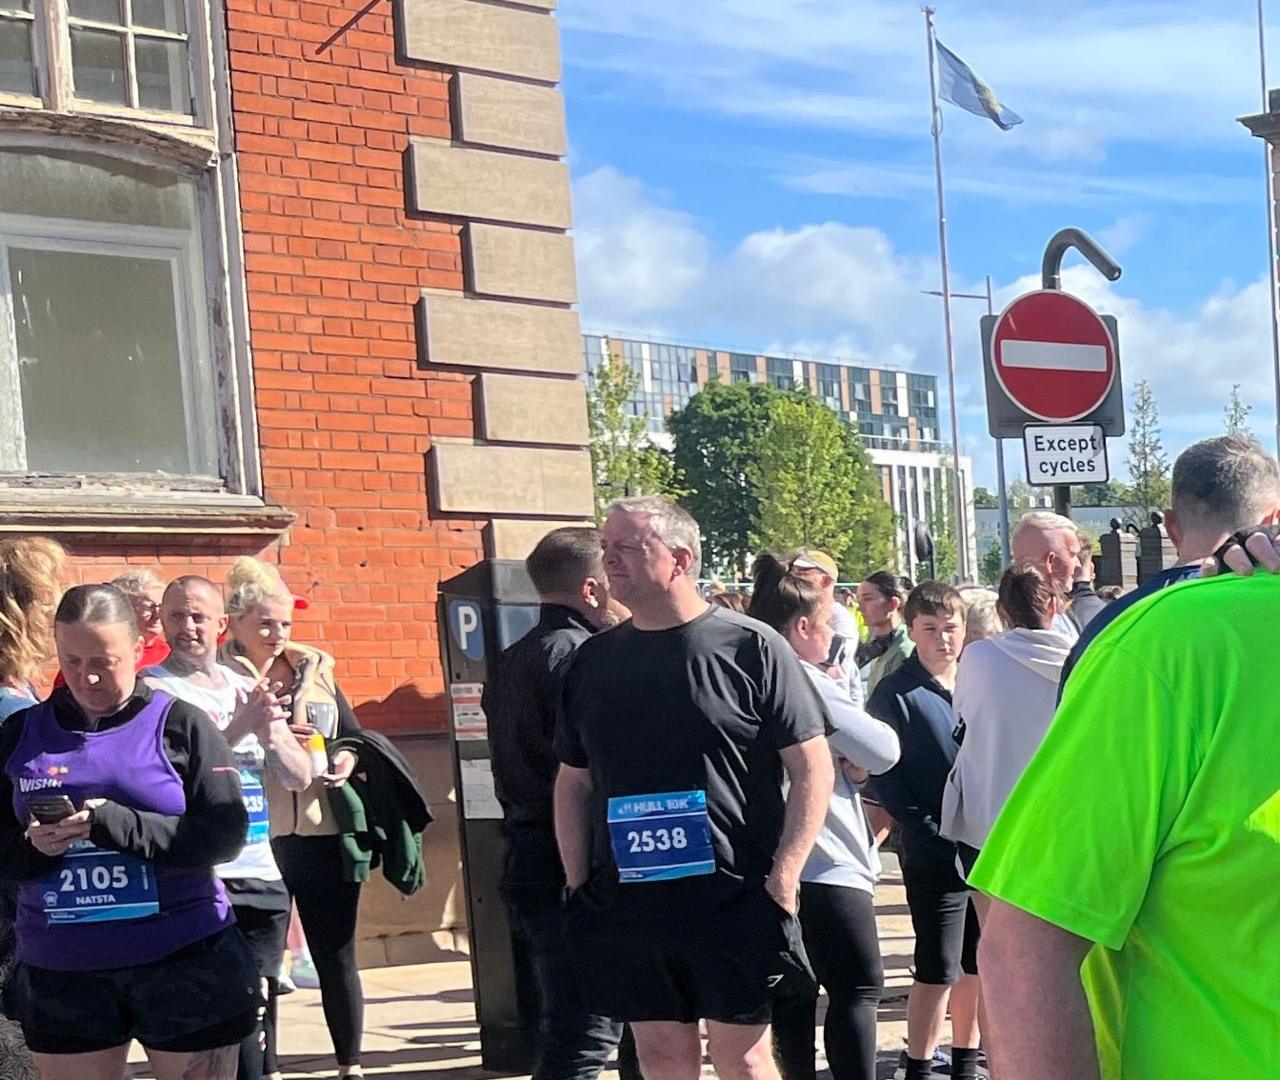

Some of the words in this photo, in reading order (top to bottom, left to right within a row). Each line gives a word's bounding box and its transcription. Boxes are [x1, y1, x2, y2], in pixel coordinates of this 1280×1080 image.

[1034, 435, 1098, 453] Except
[1039, 457, 1096, 476] cycles
[457, 605, 478, 650] P
[633, 800, 664, 813] HULL
[627, 826, 688, 853] 2538
[60, 865, 129, 892] 2105
